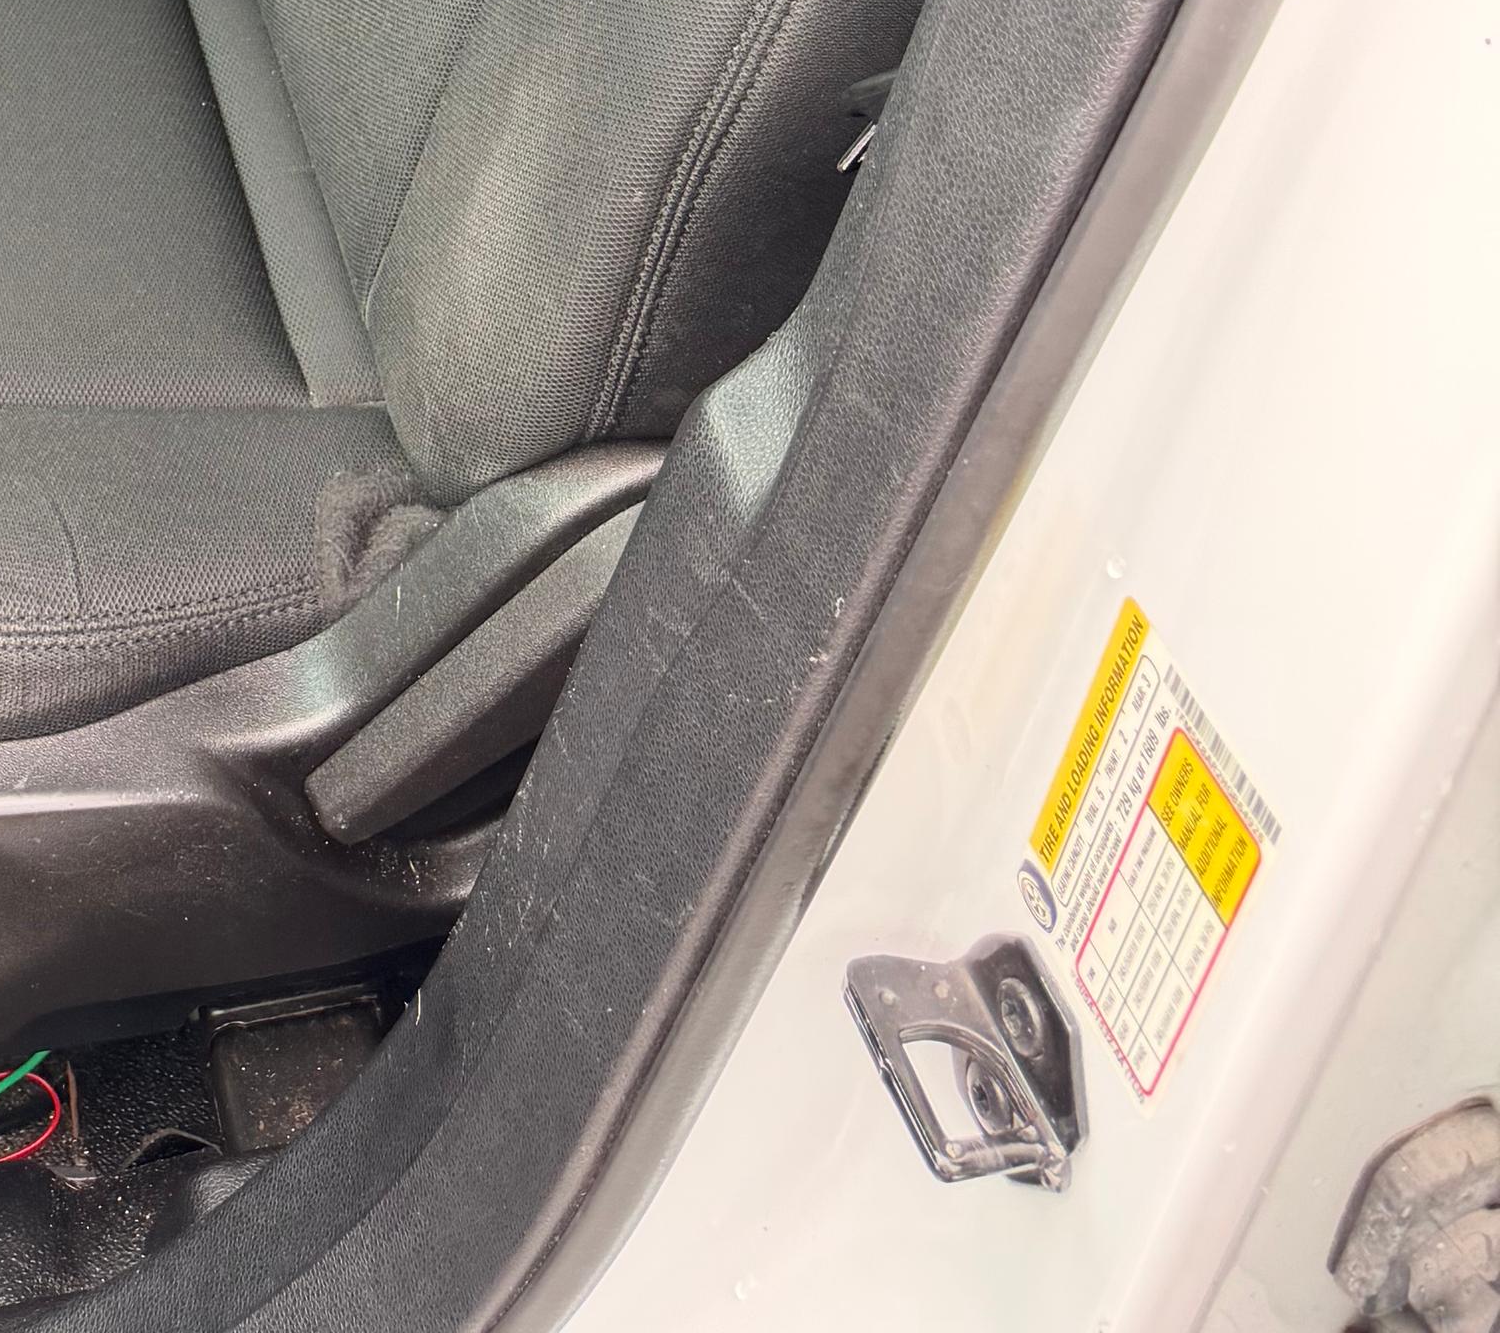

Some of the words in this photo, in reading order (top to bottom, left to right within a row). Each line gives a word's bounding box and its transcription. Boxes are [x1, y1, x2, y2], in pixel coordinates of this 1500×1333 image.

[1118, 727, 1127, 744] 2
[1141, 671, 1151, 688] 3
[1155, 705, 1170, 728] lbs.
[1040, 823, 1059, 866] TIRE
[1054, 789, 1072, 829] AND
[1067, 723, 1099, 795] LOADING
[1094, 615, 1142, 727] INFORMATION
[1136, 762, 1145, 780] or
[1139, 727, 1159, 766] 1609
[1116, 790, 1132, 822] 729
[1127, 772, 1141, 800] kg
[1160, 800, 1174, 826] SEE
[1168, 757, 1192, 804] OWNERS
[1177, 804, 1201, 853] MANUAL
[1196, 782, 1211, 810] FOR
[1195, 813, 1226, 878] ADDITIONAL
[1211, 834, 1247, 908] INFORMATION
